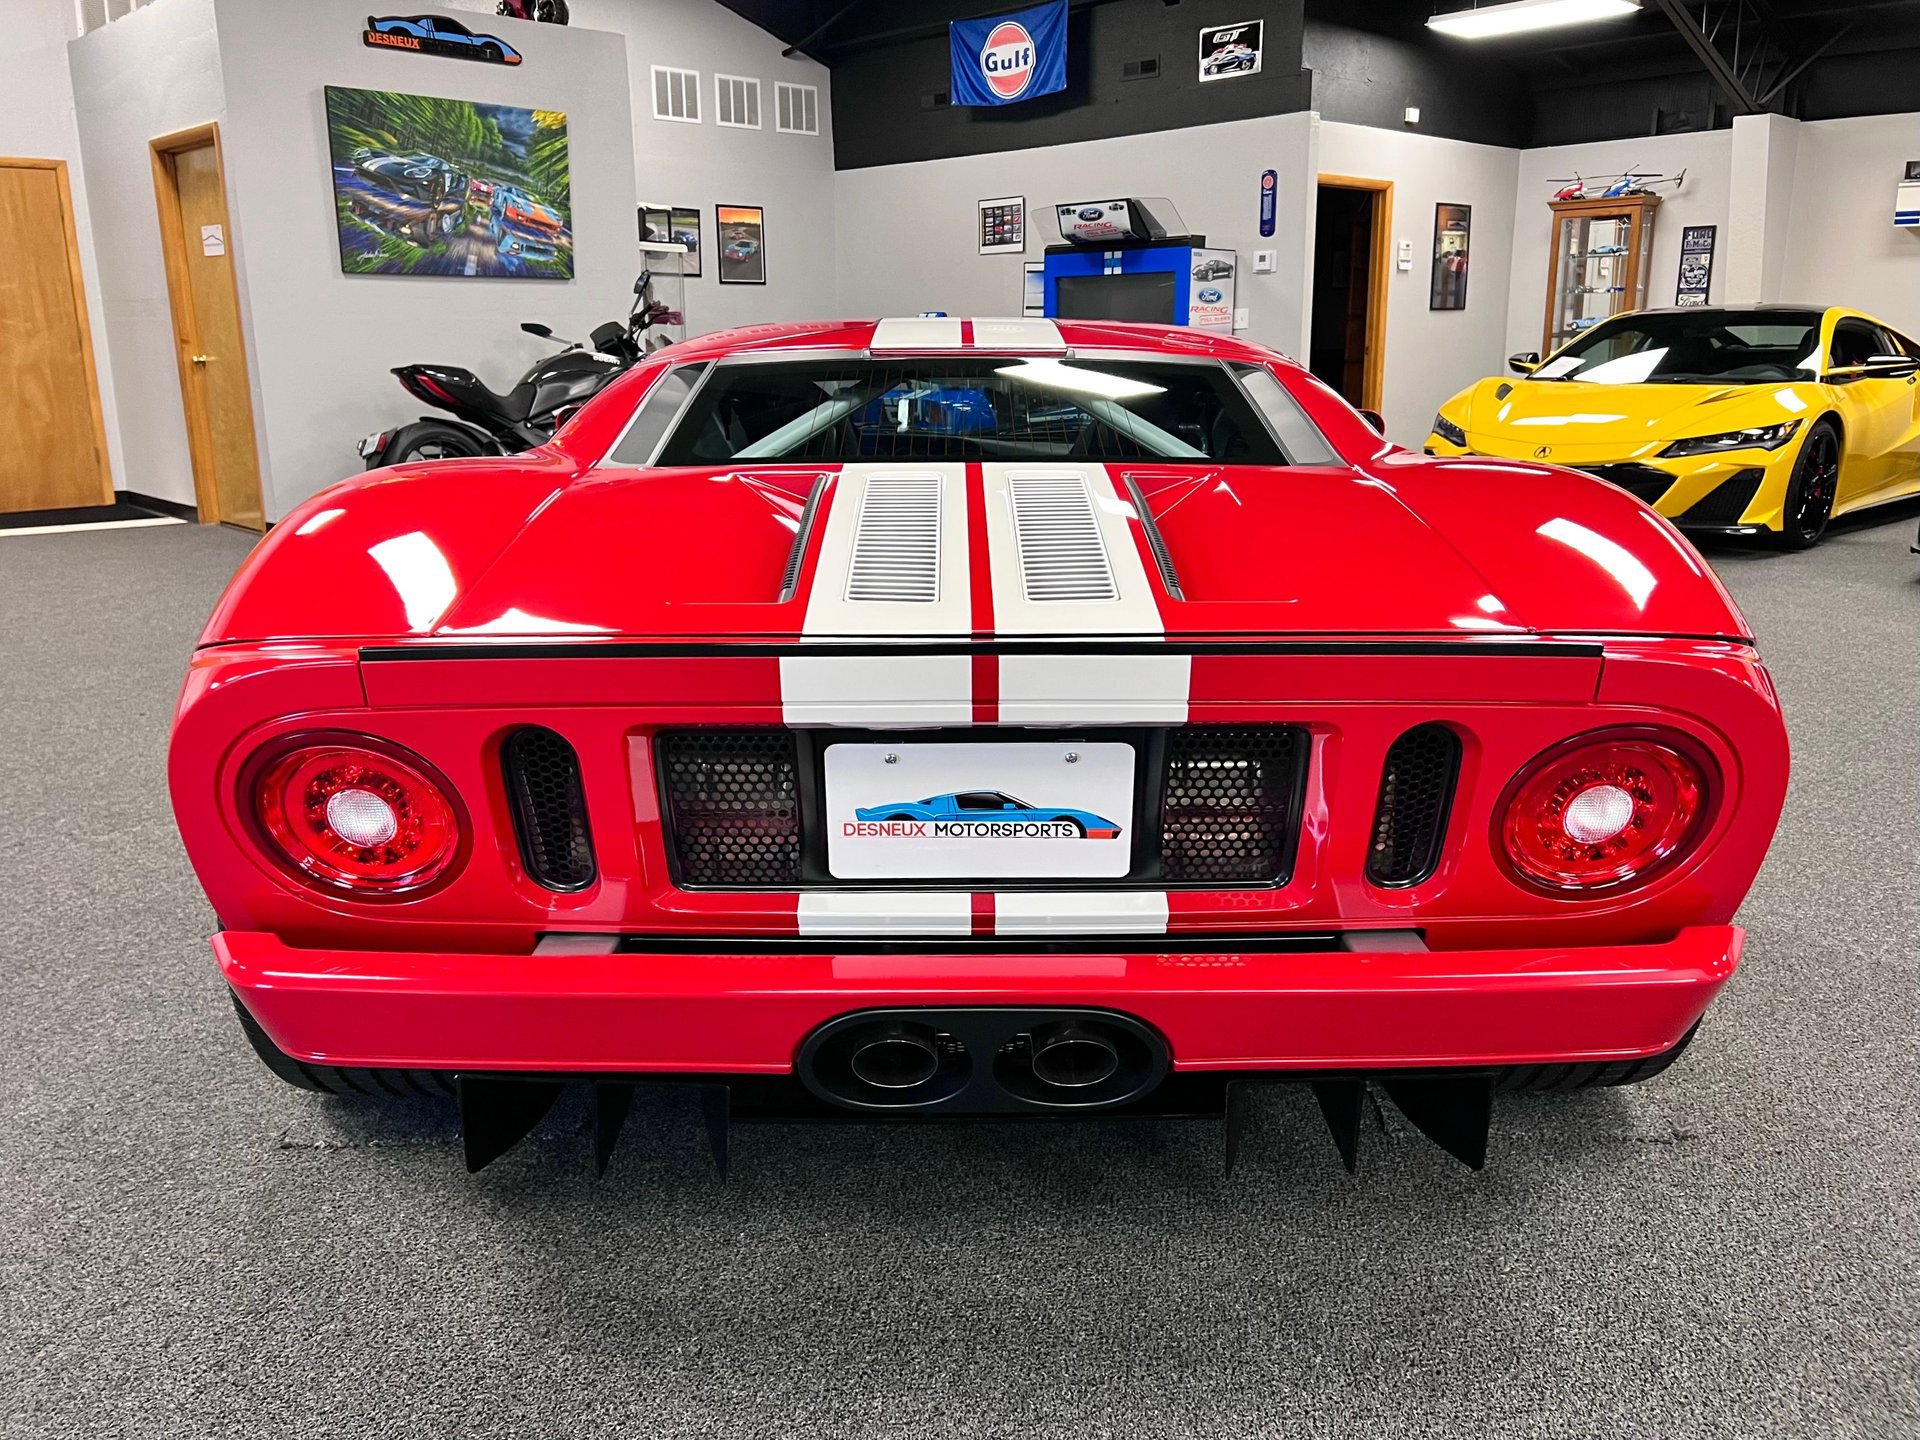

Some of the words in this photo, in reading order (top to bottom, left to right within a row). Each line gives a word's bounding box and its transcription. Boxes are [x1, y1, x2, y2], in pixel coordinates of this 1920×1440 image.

[368, 32, 421, 50] DESNEUX
[1212, 26, 1249, 43] GT
[985, 47, 1030, 72] Gulf
[1073, 221, 1113, 230] RACING
[1190, 305, 1228, 314] RACING
[842, 822, 927, 837] DESNEUX
[934, 822, 1074, 837] MOTORSPORTS
